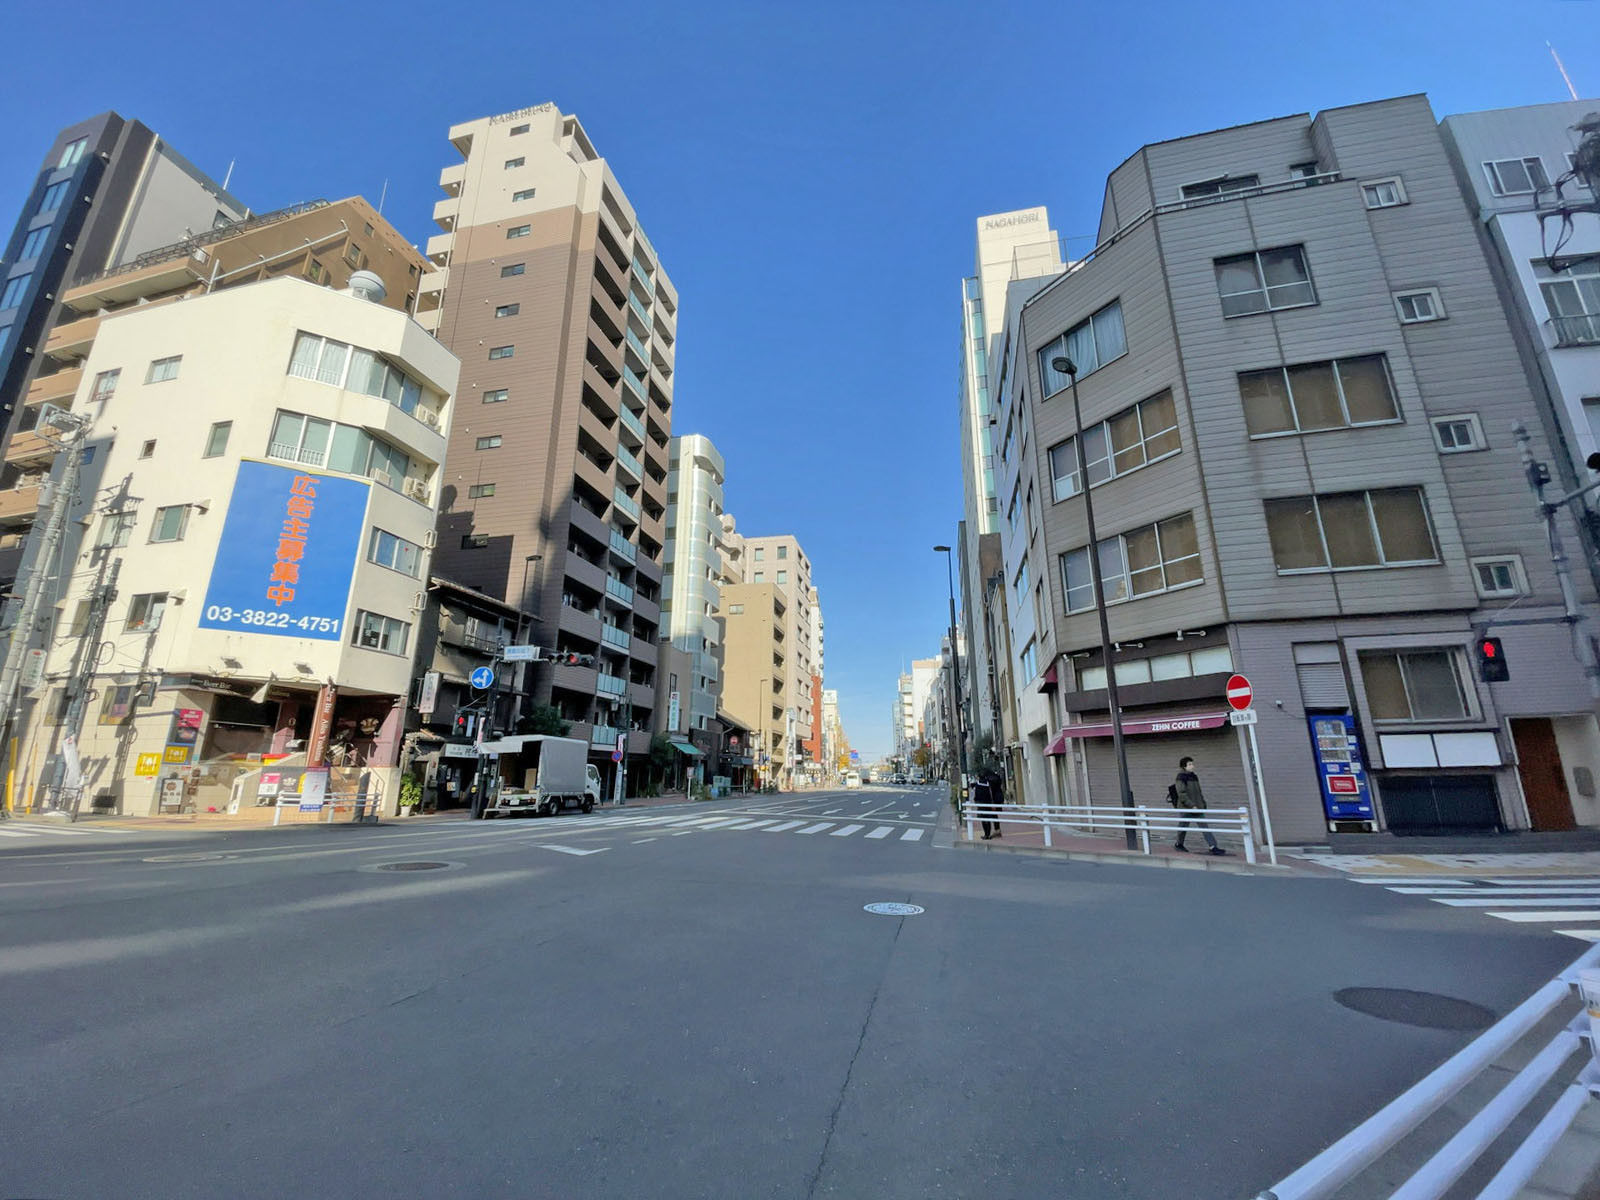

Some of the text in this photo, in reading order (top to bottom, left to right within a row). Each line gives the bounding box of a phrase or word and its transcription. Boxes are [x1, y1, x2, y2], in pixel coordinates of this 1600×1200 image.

[266, 475, 321, 607] 広告主募集中
[206, 605, 340, 634] 03-3822-4751
[1151, 720, 1200, 731] ZEHN COFFEE
